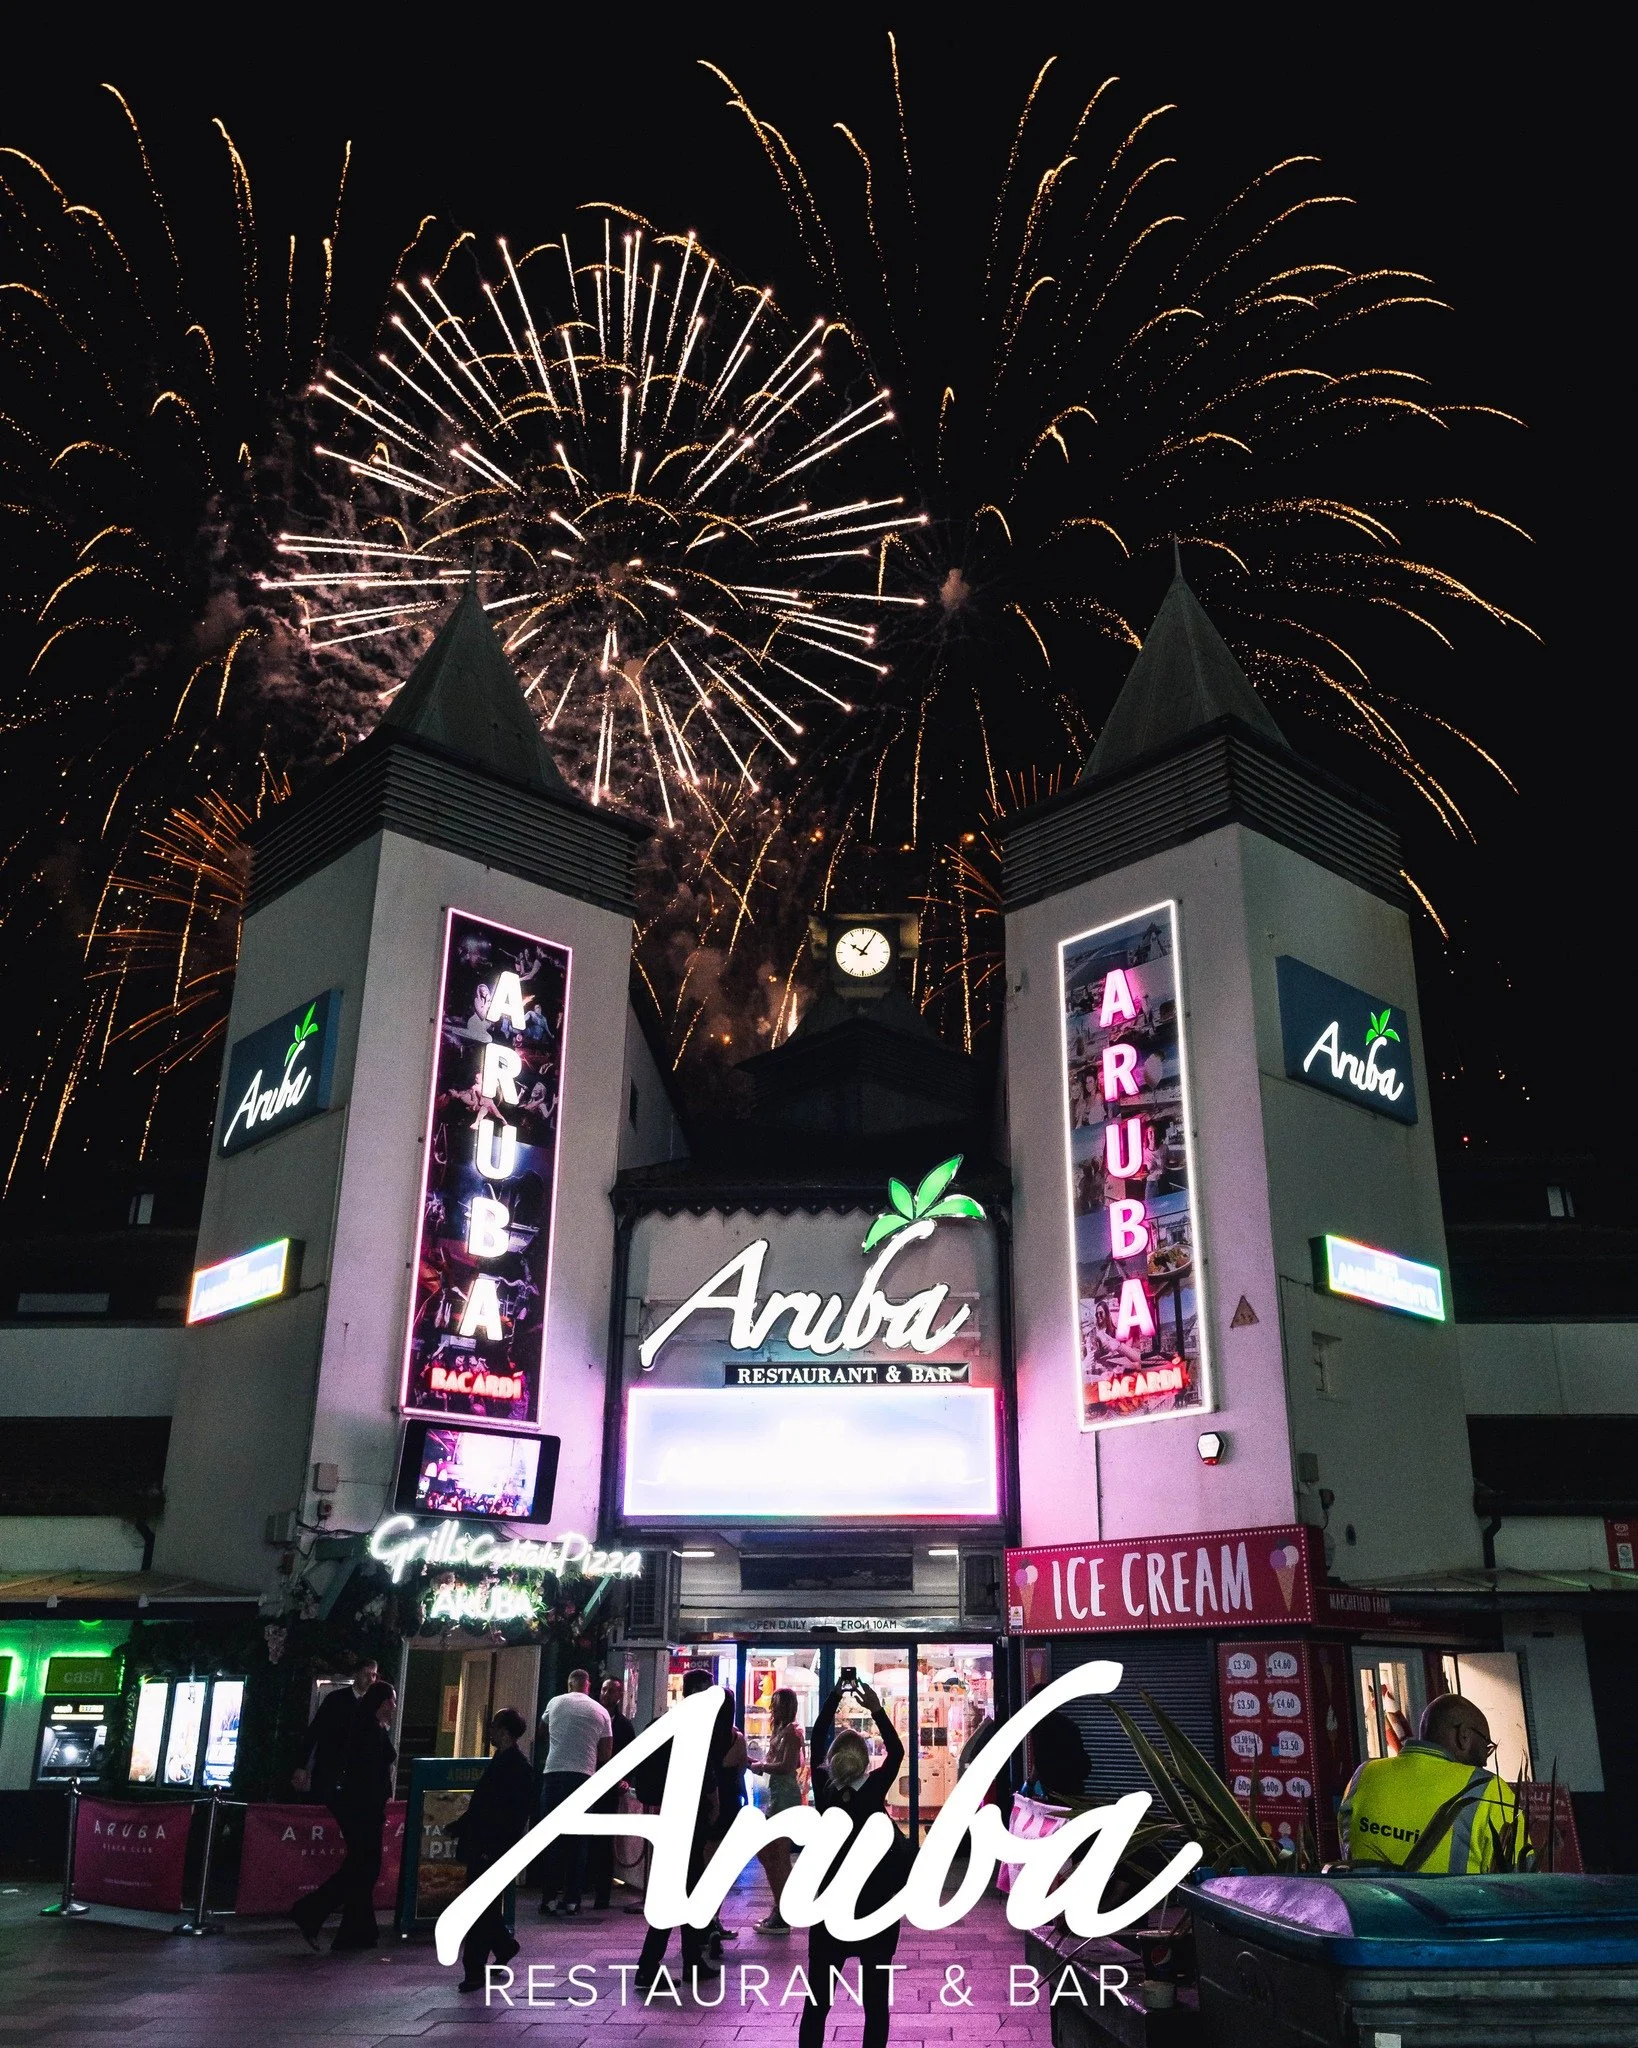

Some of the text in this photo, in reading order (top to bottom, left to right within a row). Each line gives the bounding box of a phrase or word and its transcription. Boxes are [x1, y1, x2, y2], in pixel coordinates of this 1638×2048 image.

[1303, 1019, 1405, 1102] Aruba
[222, 1040, 313, 1148] Aruba
[458, 970, 528, 1341] ARUBA
[1099, 968, 1157, 1341] ARUBA
[638, 1217, 972, 1371] Aruba
[737, 1366, 953, 1385] RESTAURANT & BAR
[370, 1514, 467, 1584] Grills
[555, 1530, 643, 1579] Pizza
[1051, 1541, 1254, 1621] ICE CREAM
[748, 1619, 897, 1630] OPEN DAILY FROM 10AM
[1233, 1660, 1251, 1670] £3.50
[1237, 1699, 1255, 1710] £3.50
[1276, 1698, 1295, 1709] £4.60
[1280, 1740, 1299, 1751] £3.50
[94, 1819, 166, 1840] ARUBA
[1360, 1816, 1420, 1844] Securi
